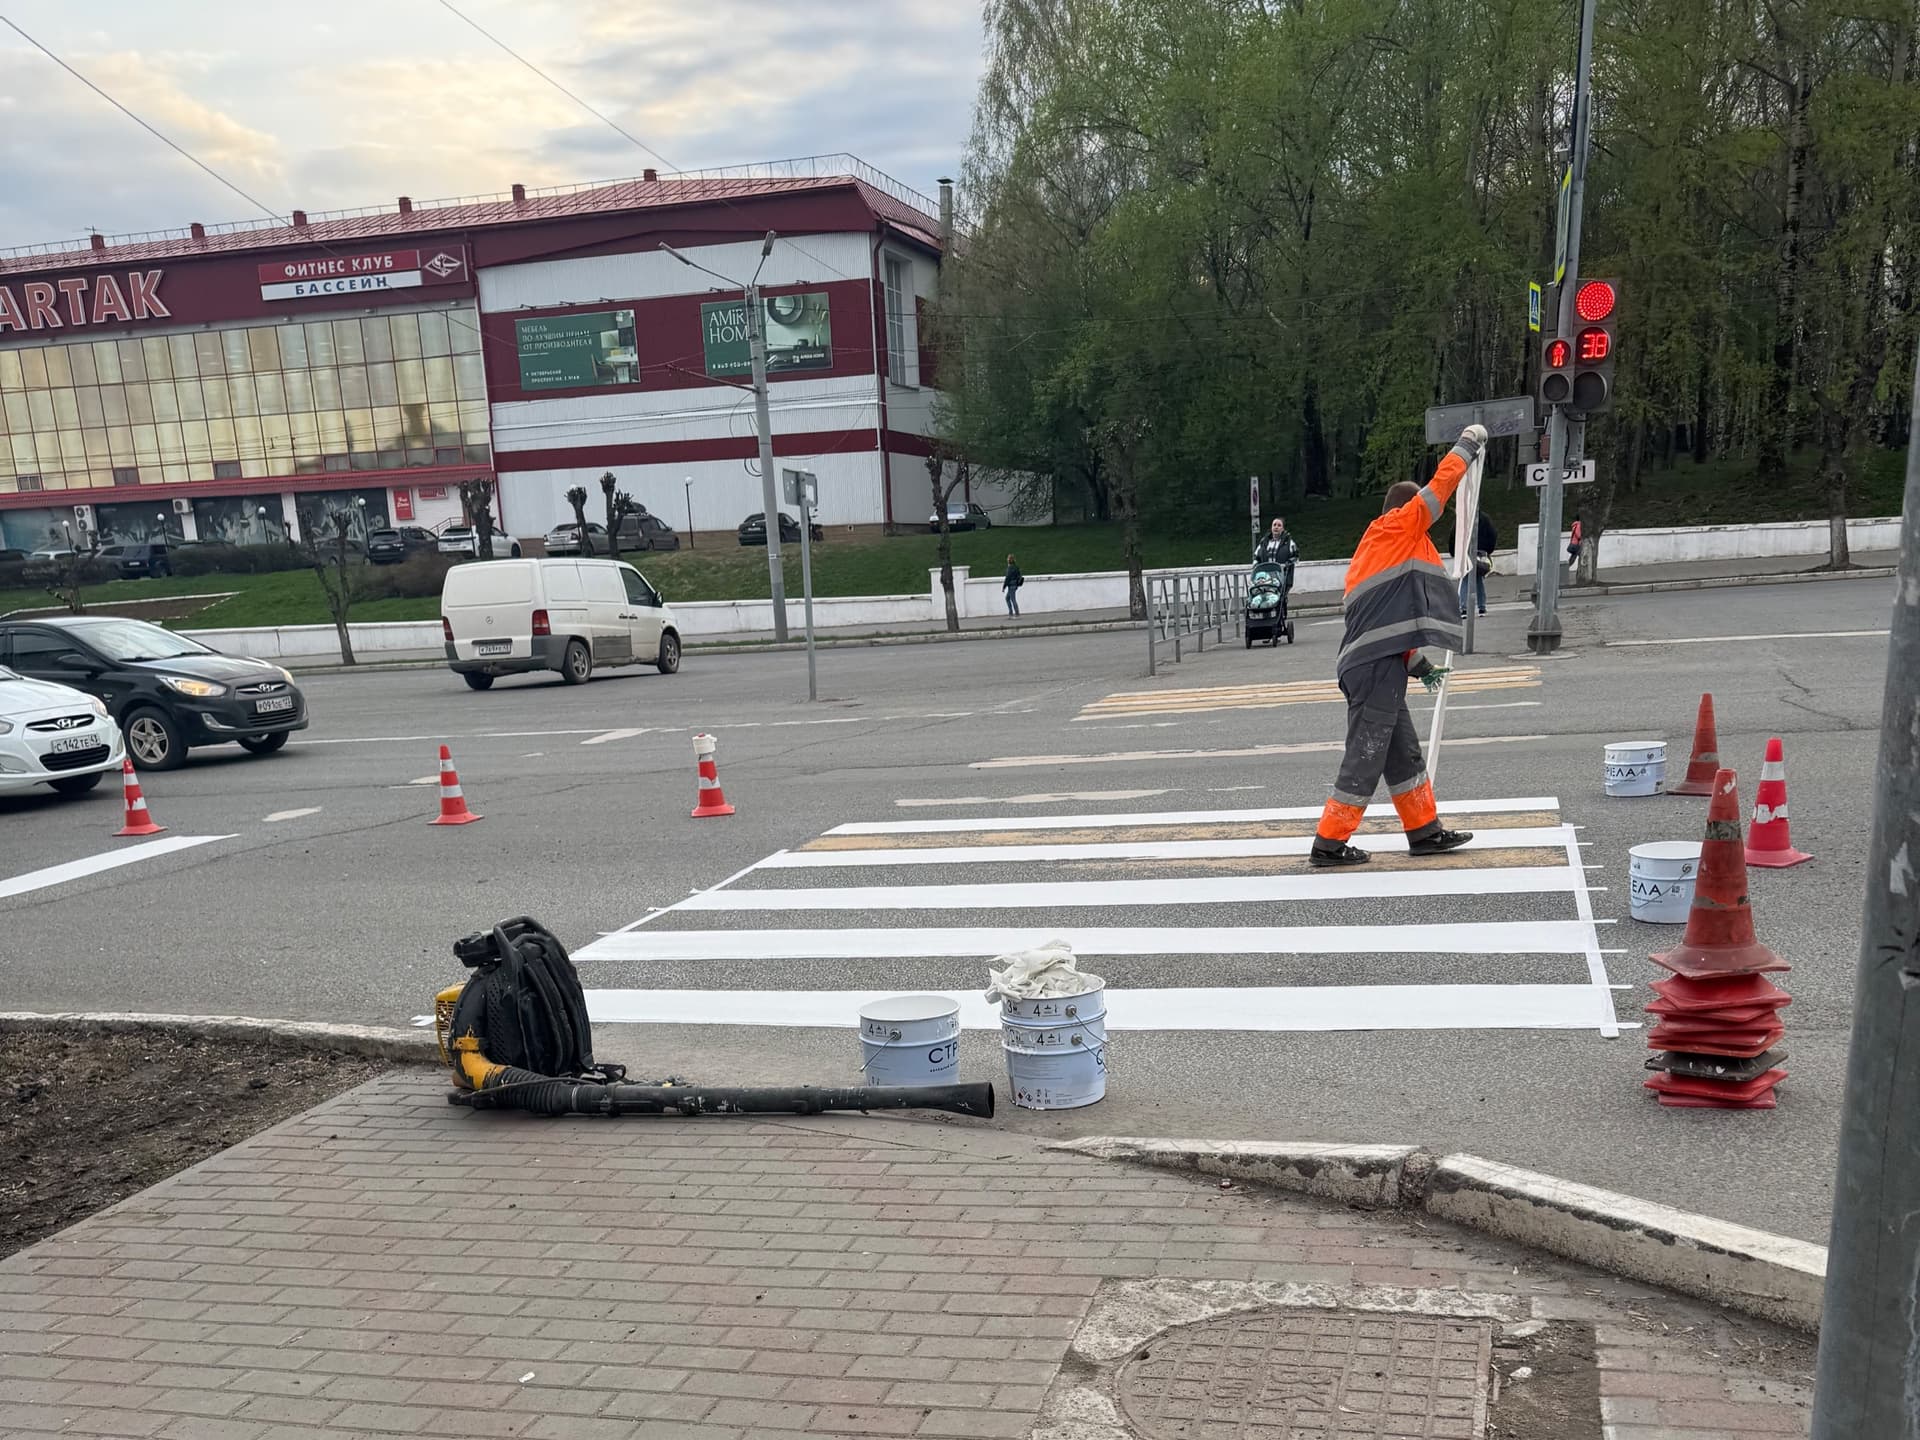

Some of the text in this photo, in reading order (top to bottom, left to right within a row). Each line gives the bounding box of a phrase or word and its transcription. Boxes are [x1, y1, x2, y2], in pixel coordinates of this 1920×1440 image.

[284, 255, 393, 277] ФИТНЕС КЛУБ
[709, 325, 750, 344] HOM
[1532, 465, 1586, 482] СП
